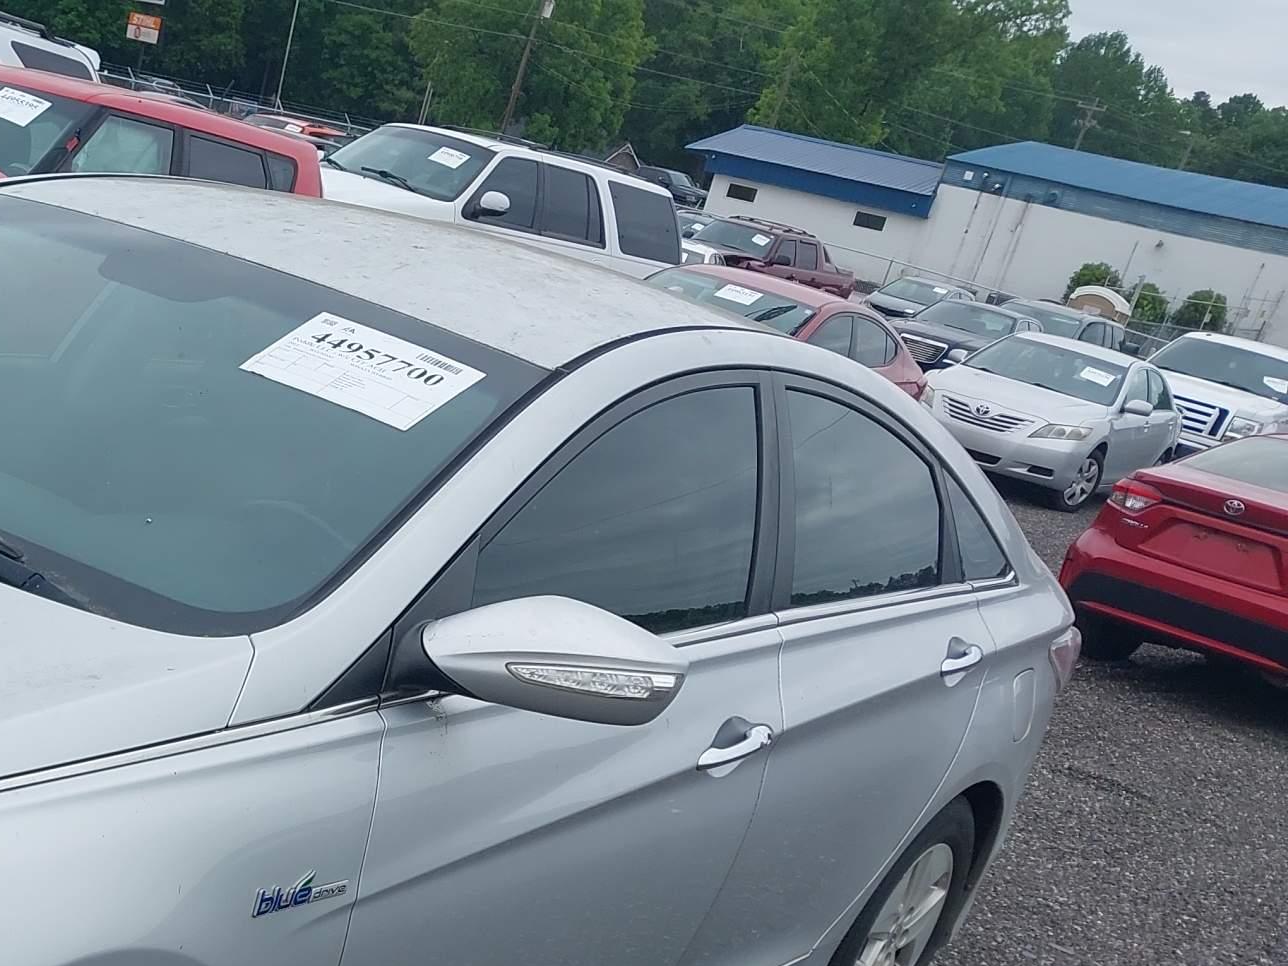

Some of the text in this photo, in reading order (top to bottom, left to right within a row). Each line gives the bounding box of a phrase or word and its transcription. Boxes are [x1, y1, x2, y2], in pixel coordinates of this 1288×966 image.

[311, 332, 445, 387] 44957700
[252, 875, 347, 918] blue drive
